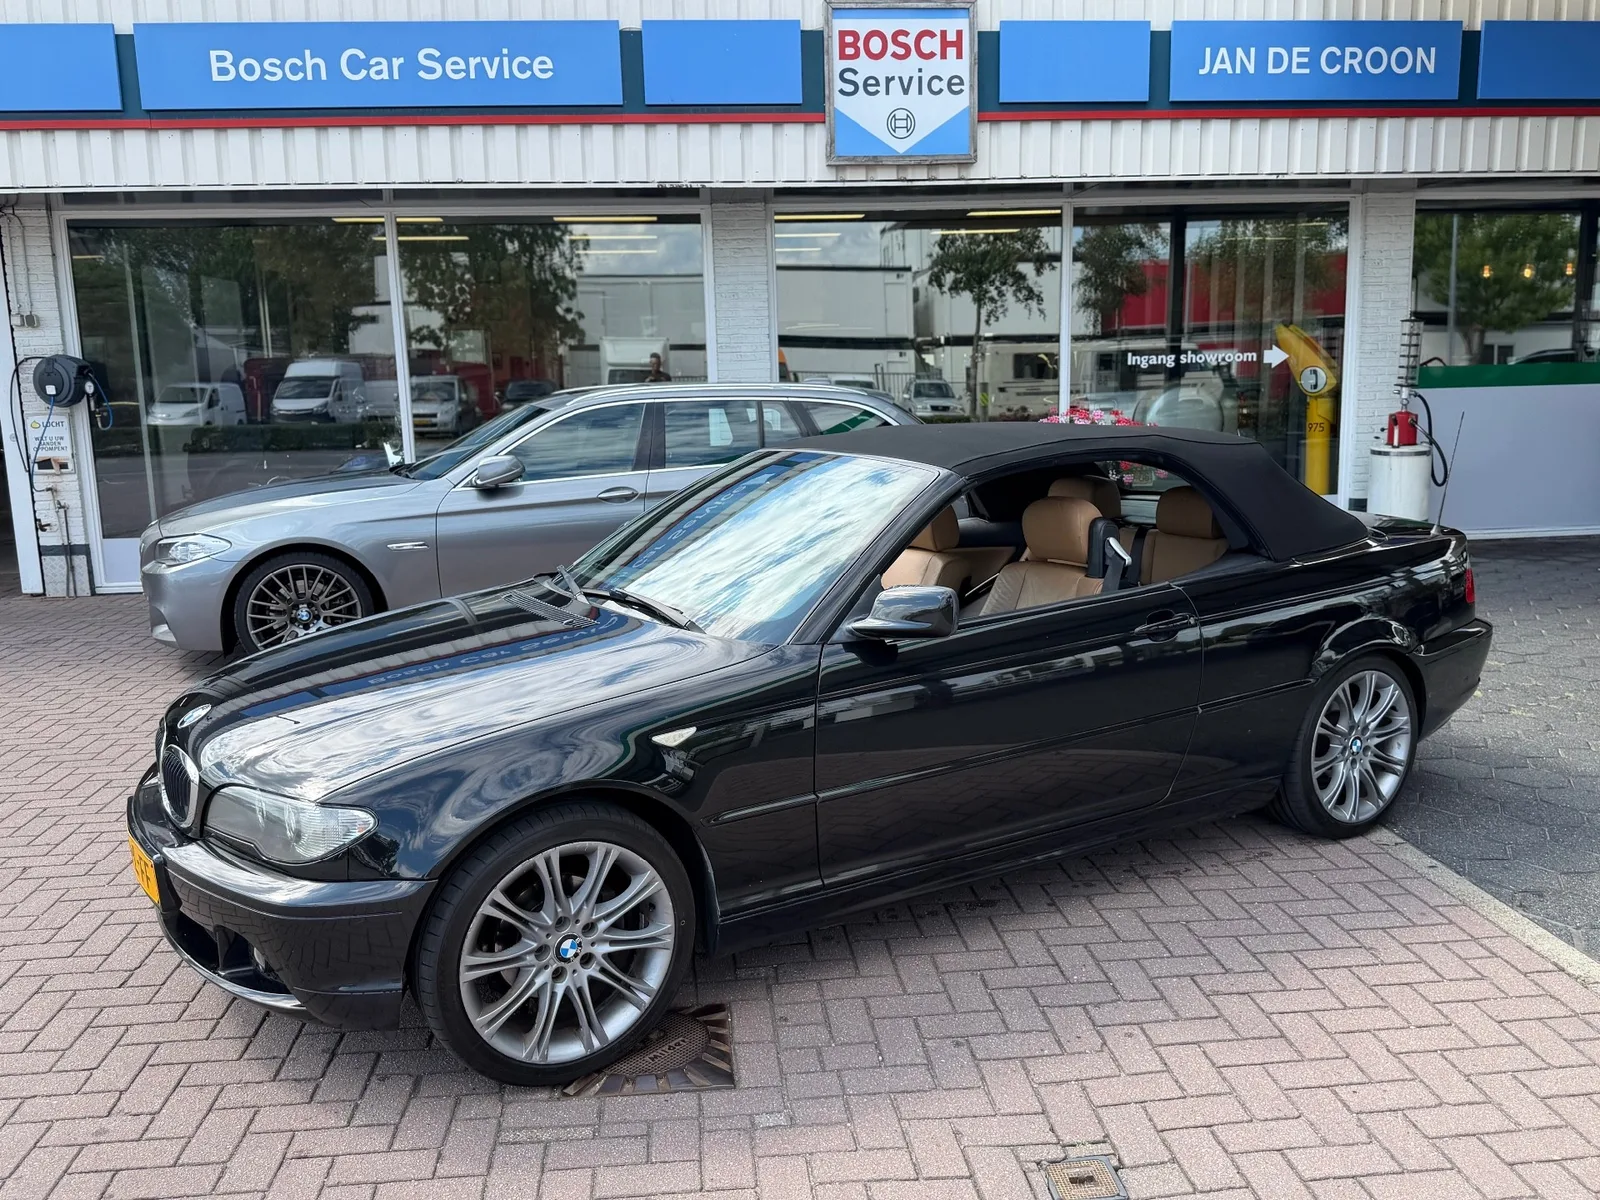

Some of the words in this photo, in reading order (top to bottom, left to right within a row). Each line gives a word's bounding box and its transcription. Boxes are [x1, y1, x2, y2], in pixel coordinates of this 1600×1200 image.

[838, 29, 963, 61] BOSCH
[209, 49, 327, 82] Bosch
[340, 48, 404, 81] Car
[417, 47, 554, 80] Service
[1198, 46, 1256, 75] JAN
[1267, 46, 1311, 74] DE
[1319, 46, 1437, 75] CROON
[838, 67, 965, 97] Service
[1127, 352, 1176, 369] Ingang
[1180, 350, 1257, 364] showroom
[1307, 422, 1325, 433] 975
